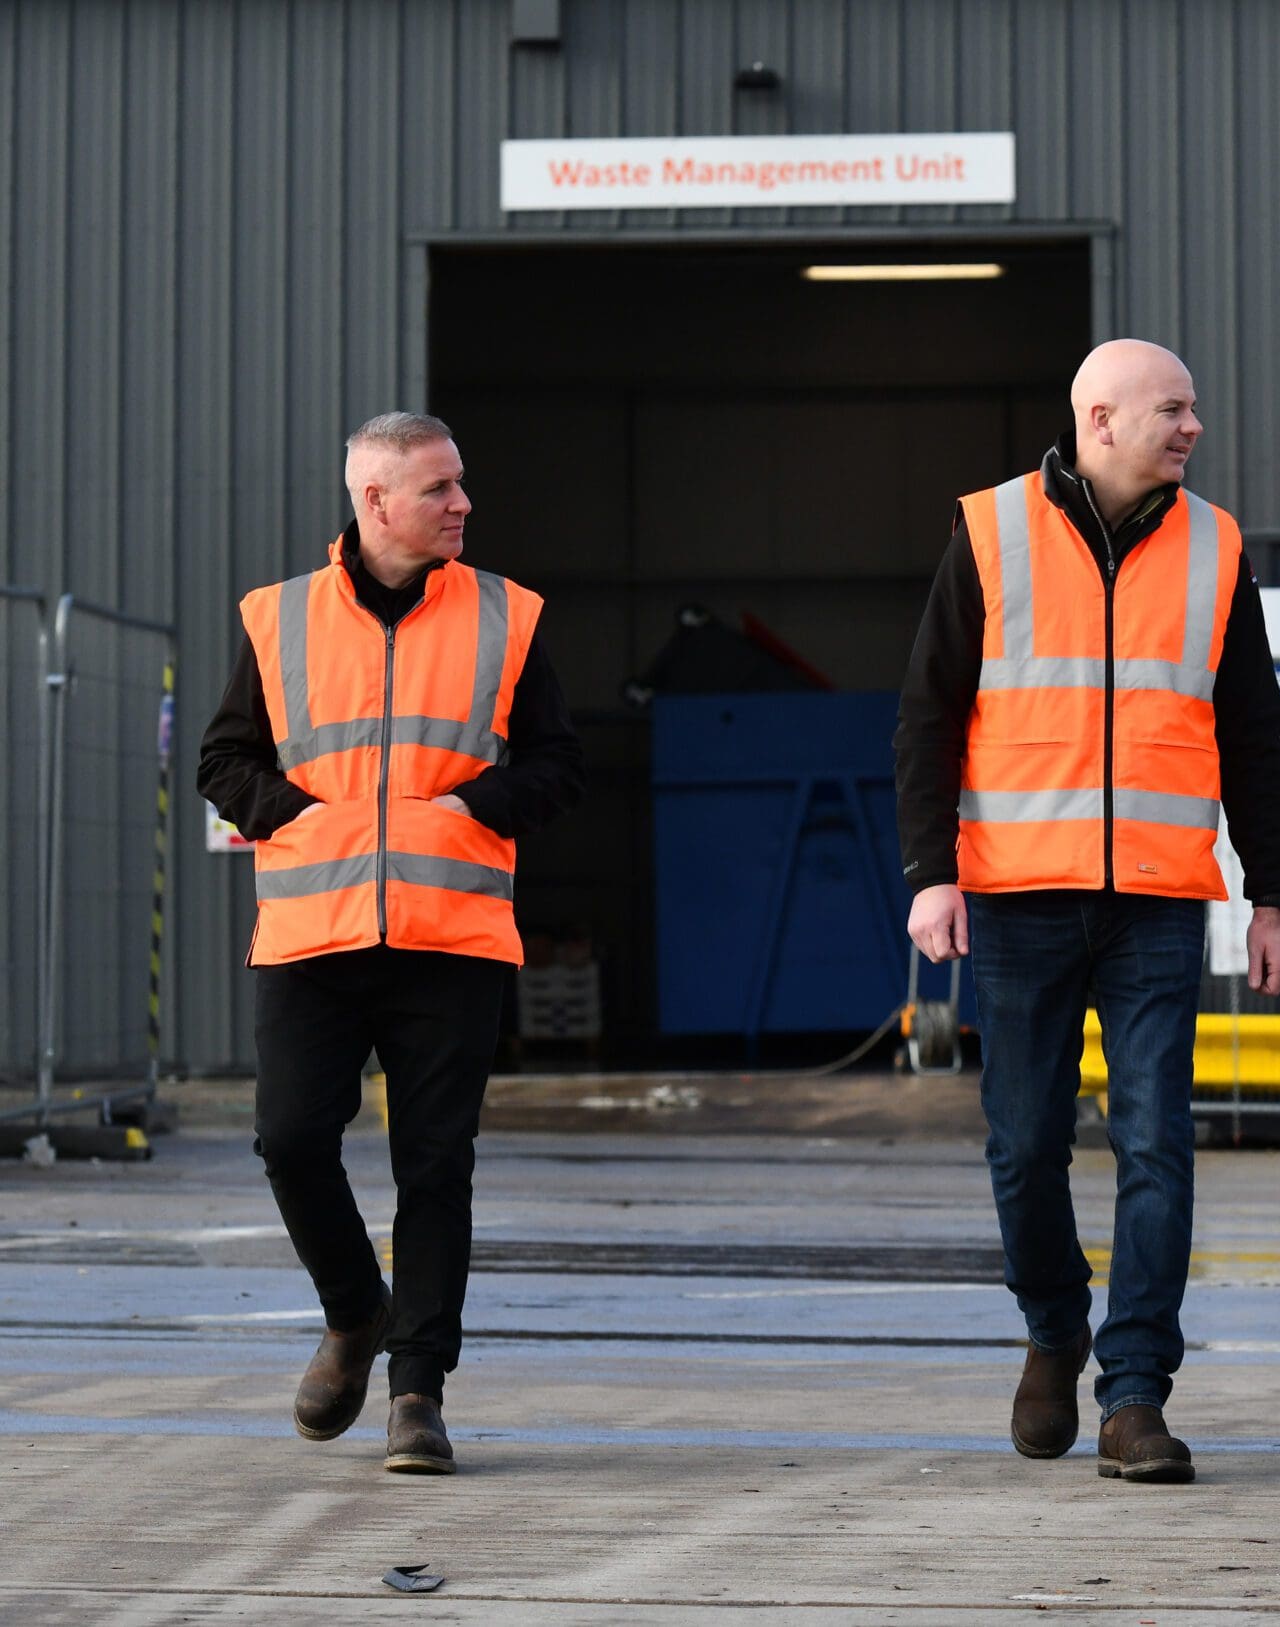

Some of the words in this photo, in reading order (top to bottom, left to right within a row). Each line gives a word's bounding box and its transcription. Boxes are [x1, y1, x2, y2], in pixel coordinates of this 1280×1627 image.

[549, 160, 650, 187] Waste
[662, 157, 882, 190] Management
[895, 153, 965, 181] Unit
